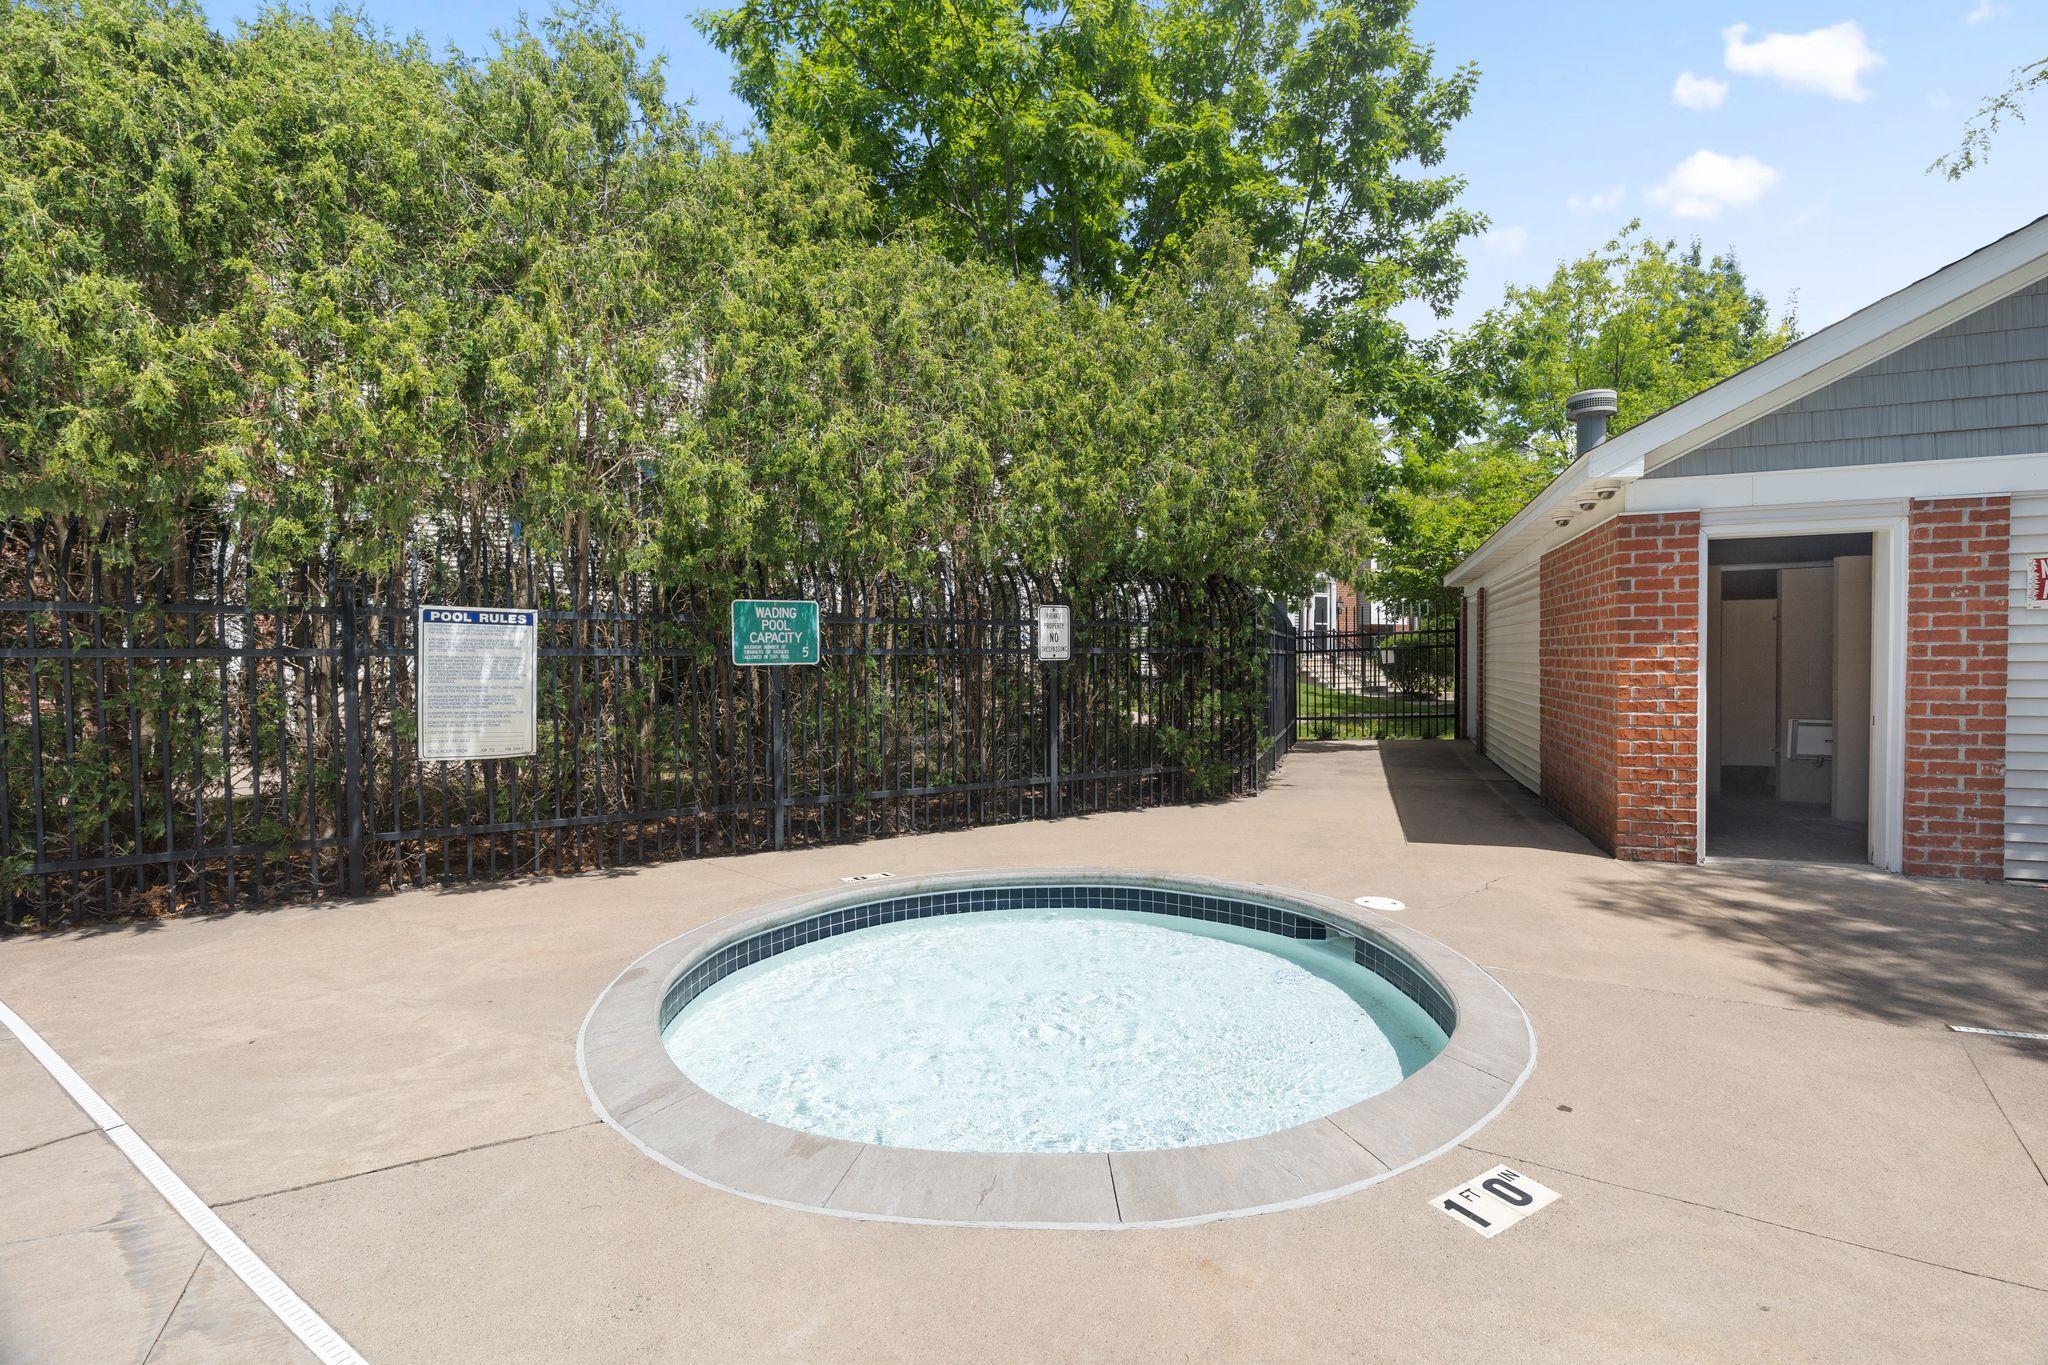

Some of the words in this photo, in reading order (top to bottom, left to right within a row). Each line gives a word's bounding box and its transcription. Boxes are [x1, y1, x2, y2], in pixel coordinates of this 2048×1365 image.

[430, 611, 472, 622] POOL
[479, 613, 527, 624] RULES
[755, 606, 797, 619] WADING
[761, 620, 791, 631] POOL
[749, 632, 803, 643] CAPACITY
[1050, 632, 1059, 643] NO
[802, 646, 809, 658] 5
[1041, 645, 1068, 653] TRESPASSING
[1497, 1169, 1520, 1182] IN
[1458, 1187, 1481, 1202] FT
[1482, 1178, 1533, 1206] 0
[1443, 1198, 1492, 1228] 1
